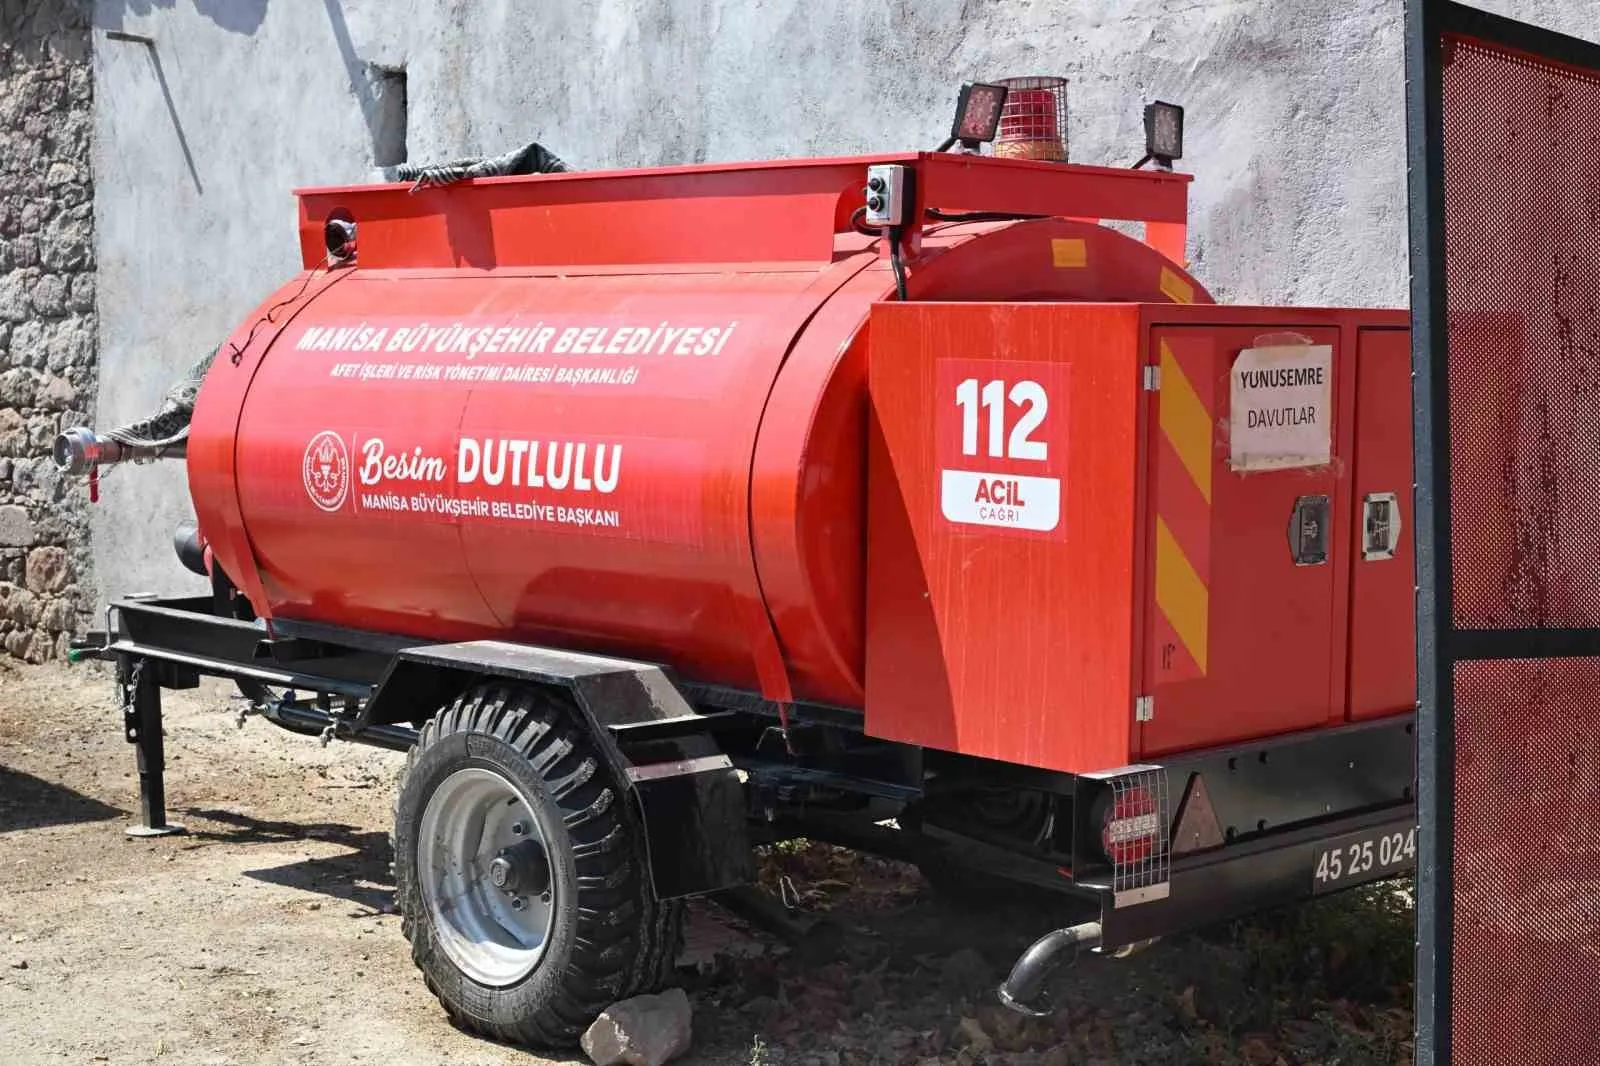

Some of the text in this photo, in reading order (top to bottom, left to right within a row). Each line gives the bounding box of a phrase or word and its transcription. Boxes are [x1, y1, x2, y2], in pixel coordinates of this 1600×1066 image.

[296, 321, 737, 360] MANİSA BÜYÜKŞEHİR BELEDİYESİ
[330, 363, 362, 377] AFET
[359, 361, 399, 381] İŞLERİ
[397, 364, 415, 379] VE
[444, 363, 504, 381] YÖNETİMİ
[502, 364, 557, 382] DAİRESİ
[554, 366, 639, 388] BAŞKANLIĞI
[1240, 366, 1323, 390] YUNUSEMRE
[956, 378, 1048, 461] 112
[1248, 406, 1316, 429] DAVUTLAR
[359, 437, 446, 486] Besim
[458, 437, 622, 493] DUTLULU
[361, 491, 619, 527] MANİSA BÜYÜKŞEHİR BELEDİYE BAŞKANI
[975, 479, 1025, 507] ACİL
[1316, 828, 1416, 882] 45 25 024
